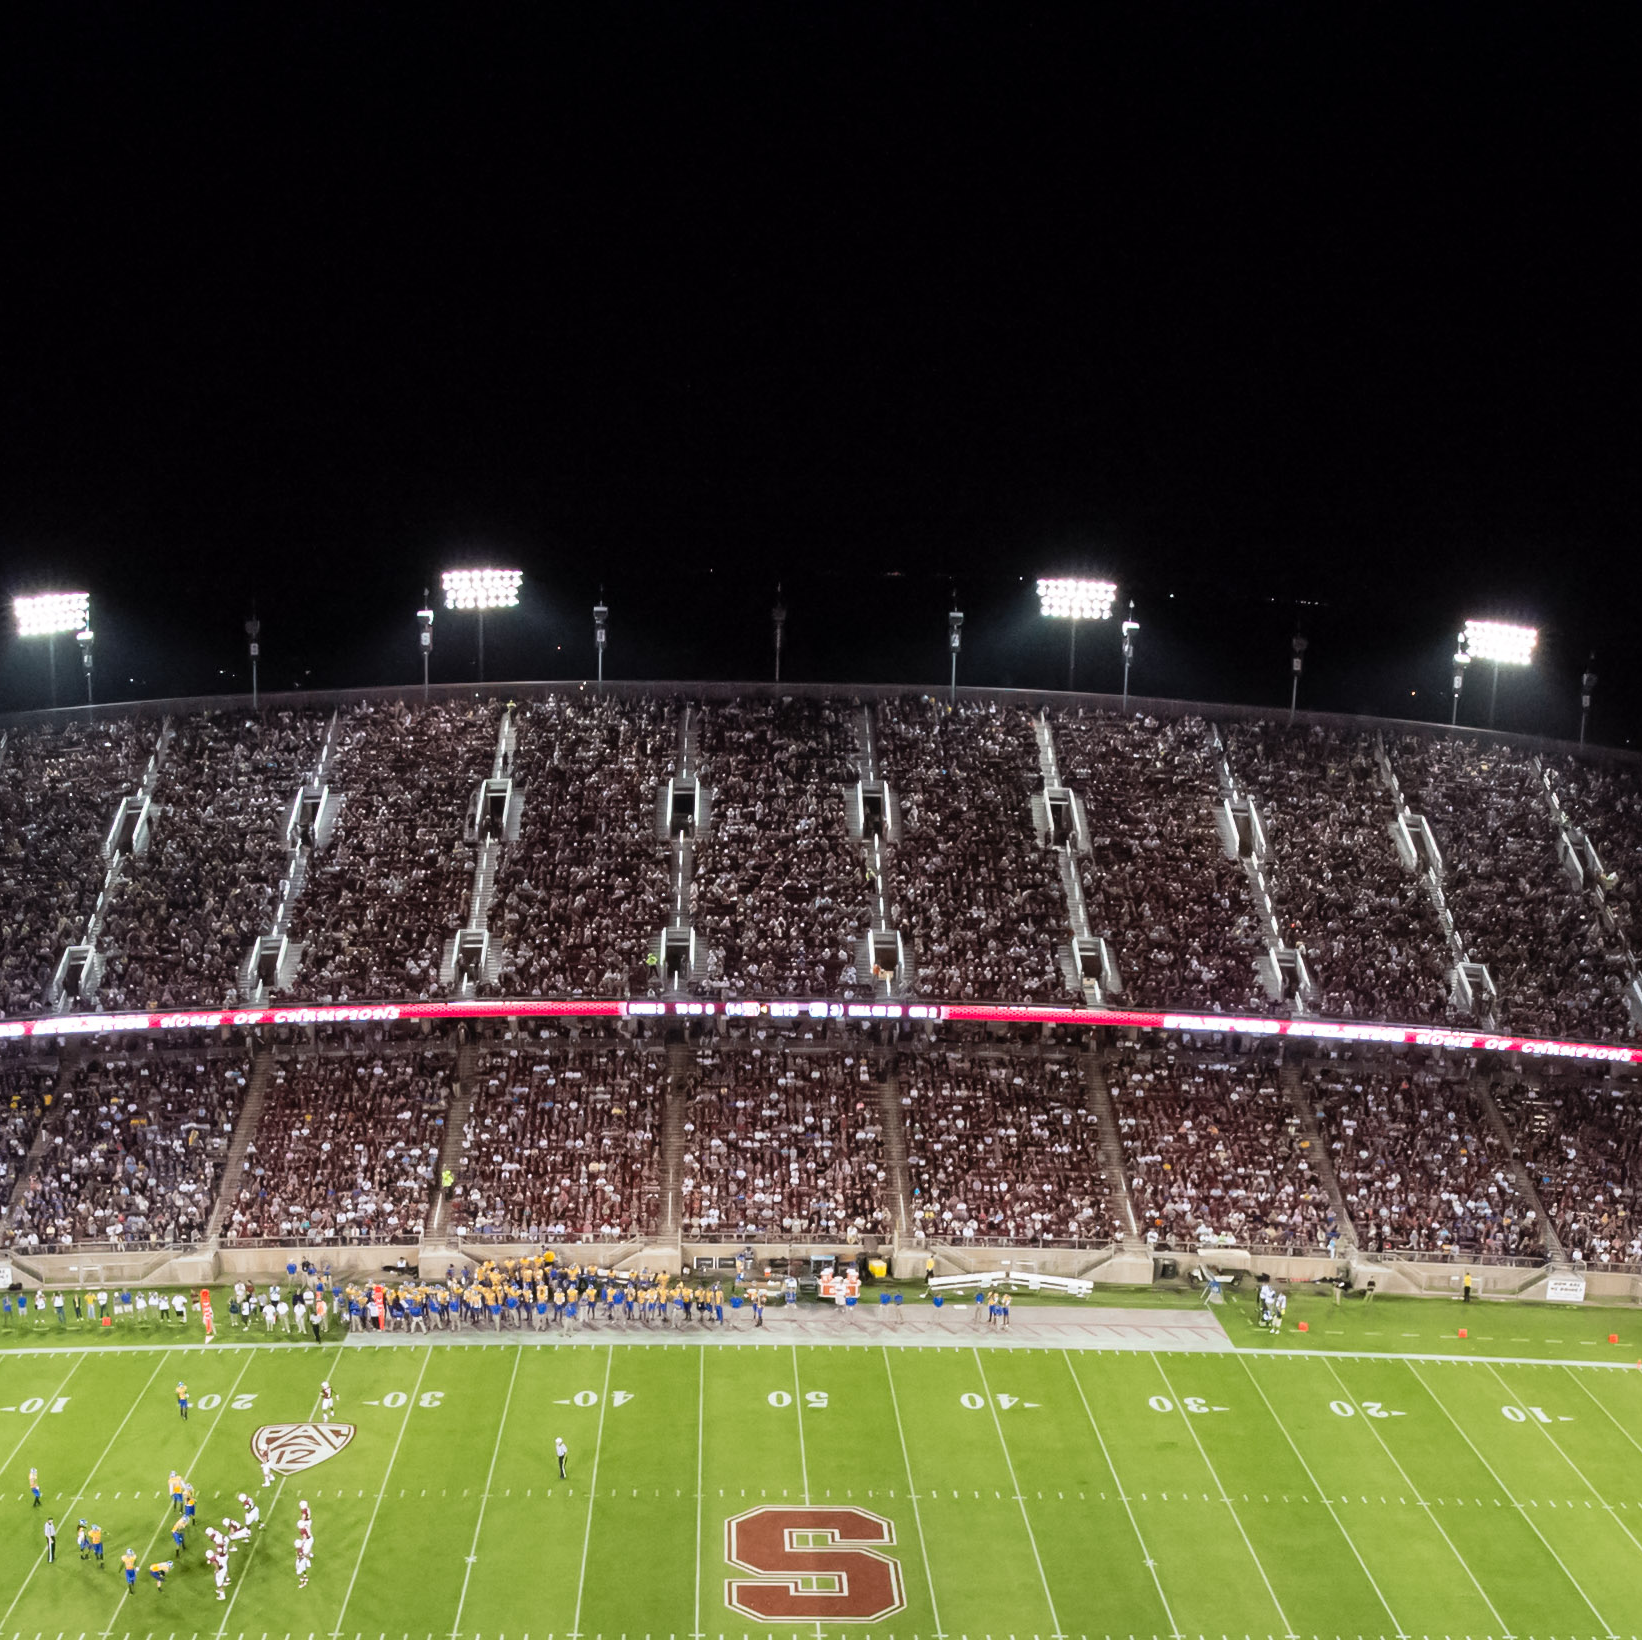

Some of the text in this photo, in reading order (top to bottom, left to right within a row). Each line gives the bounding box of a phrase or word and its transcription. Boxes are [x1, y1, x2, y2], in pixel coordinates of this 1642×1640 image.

[159, 1014, 223, 1028] HOME
[232, 1011, 263, 1025] OF
[274, 1006, 401, 1024] CHAMPIONS
[1415, 1033, 1476, 1048] HOME
[1483, 1038, 1512, 1051] OF
[1522, 1041, 1633, 1062] CHAMPIONS
[18, 1396, 71, 1414] 10
[194, 1393, 256, 1411] 20
[377, 1390, 446, 1409] 30
[573, 1389, 635, 1408] 40
[767, 1389, 829, 1408] 50
[960, 1391, 1021, 1410] 40
[1149, 1394, 1209, 1414] 30
[1330, 1399, 1385, 1419] 20
[1502, 1405, 1557, 1424] 10
[265, 1424, 353, 1448] PAC
[273, 1448, 317, 1466] 12
[724, 1504, 908, 1623] S
